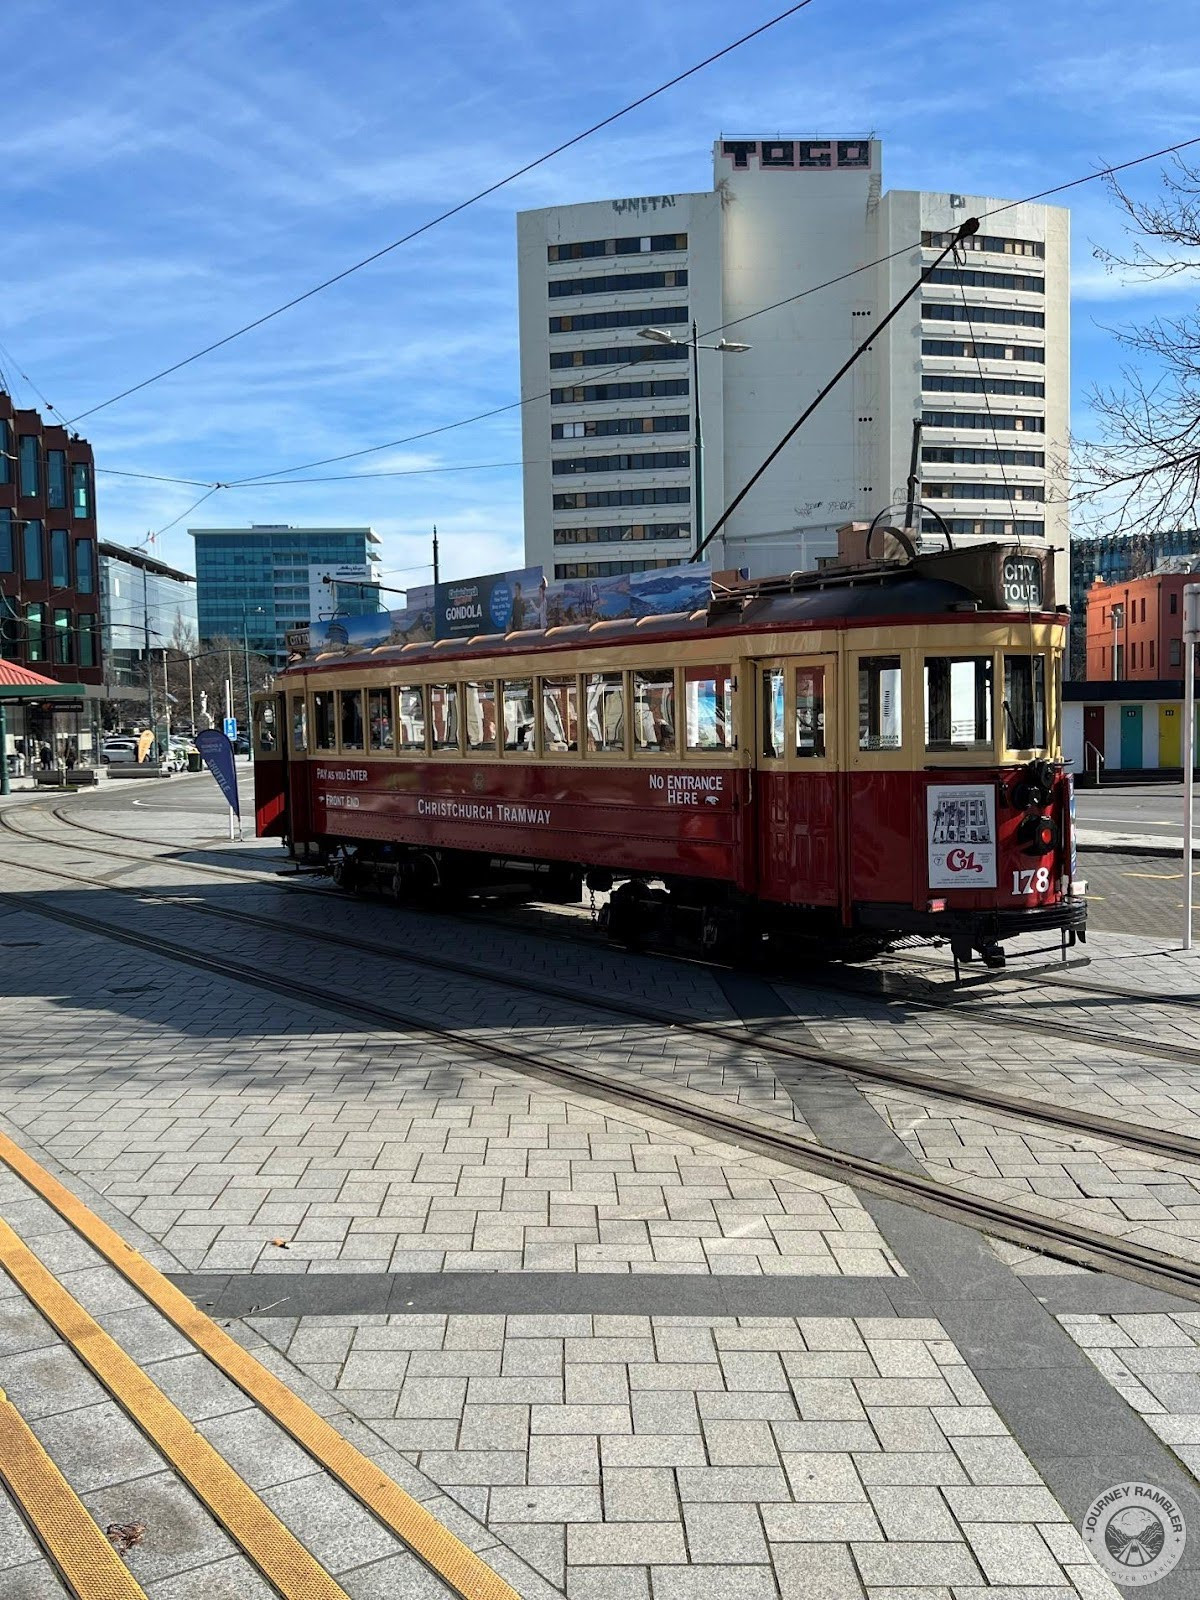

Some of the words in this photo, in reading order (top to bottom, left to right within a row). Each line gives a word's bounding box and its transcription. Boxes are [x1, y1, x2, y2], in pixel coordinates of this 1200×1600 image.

[1005, 564, 1034, 580] CITY
[1003, 584, 1039, 602] TOUR
[446, 604, 482, 621] GONDOLA
[301, 633, 310, 644] TO
[209, 759, 231, 792] SHUTTLE
[317, 768, 327, 779] PAY
[328, 771, 336, 780] AS
[336, 771, 346, 780] YOU
[346, 769, 368, 781] ENTER
[649, 774, 664, 789] NO
[667, 775, 723, 790] ENTRANCE
[326, 795, 345, 806] FRONT
[346, 796, 360, 808] END
[667, 790, 698, 804] HERE
[418, 799, 493, 820] CHRISTCHURCH
[497, 804, 551, 824] TRAMWAY
[1012, 867, 1049, 895] 178
